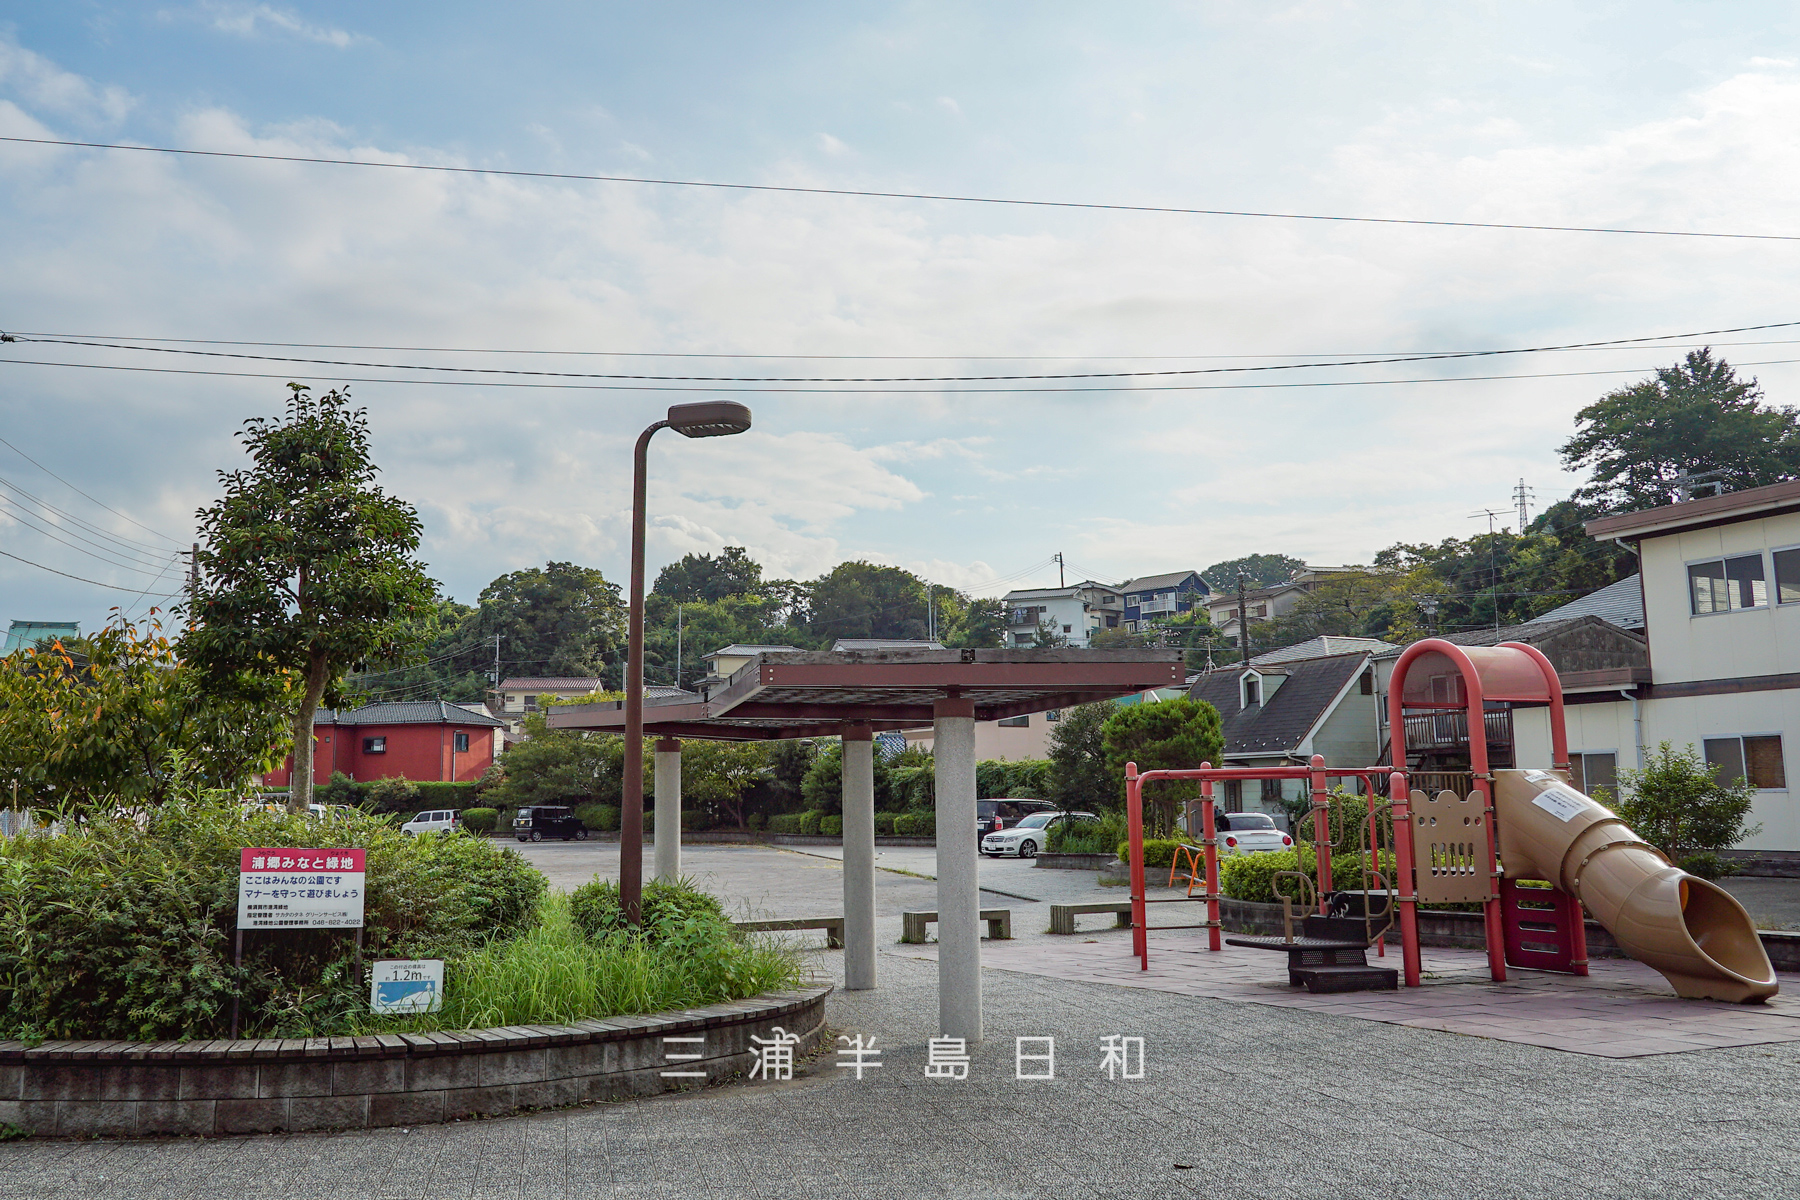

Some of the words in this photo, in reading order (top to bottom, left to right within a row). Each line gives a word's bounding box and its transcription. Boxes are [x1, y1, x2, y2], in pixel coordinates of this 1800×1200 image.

[252, 857, 354, 869] 浦郷みなと緑地
[245, 876, 341, 885] ここはみんなの公園です
[245, 889, 358, 899] マナーを守って遊びましょう
[392, 970, 422, 981] 1.2m
